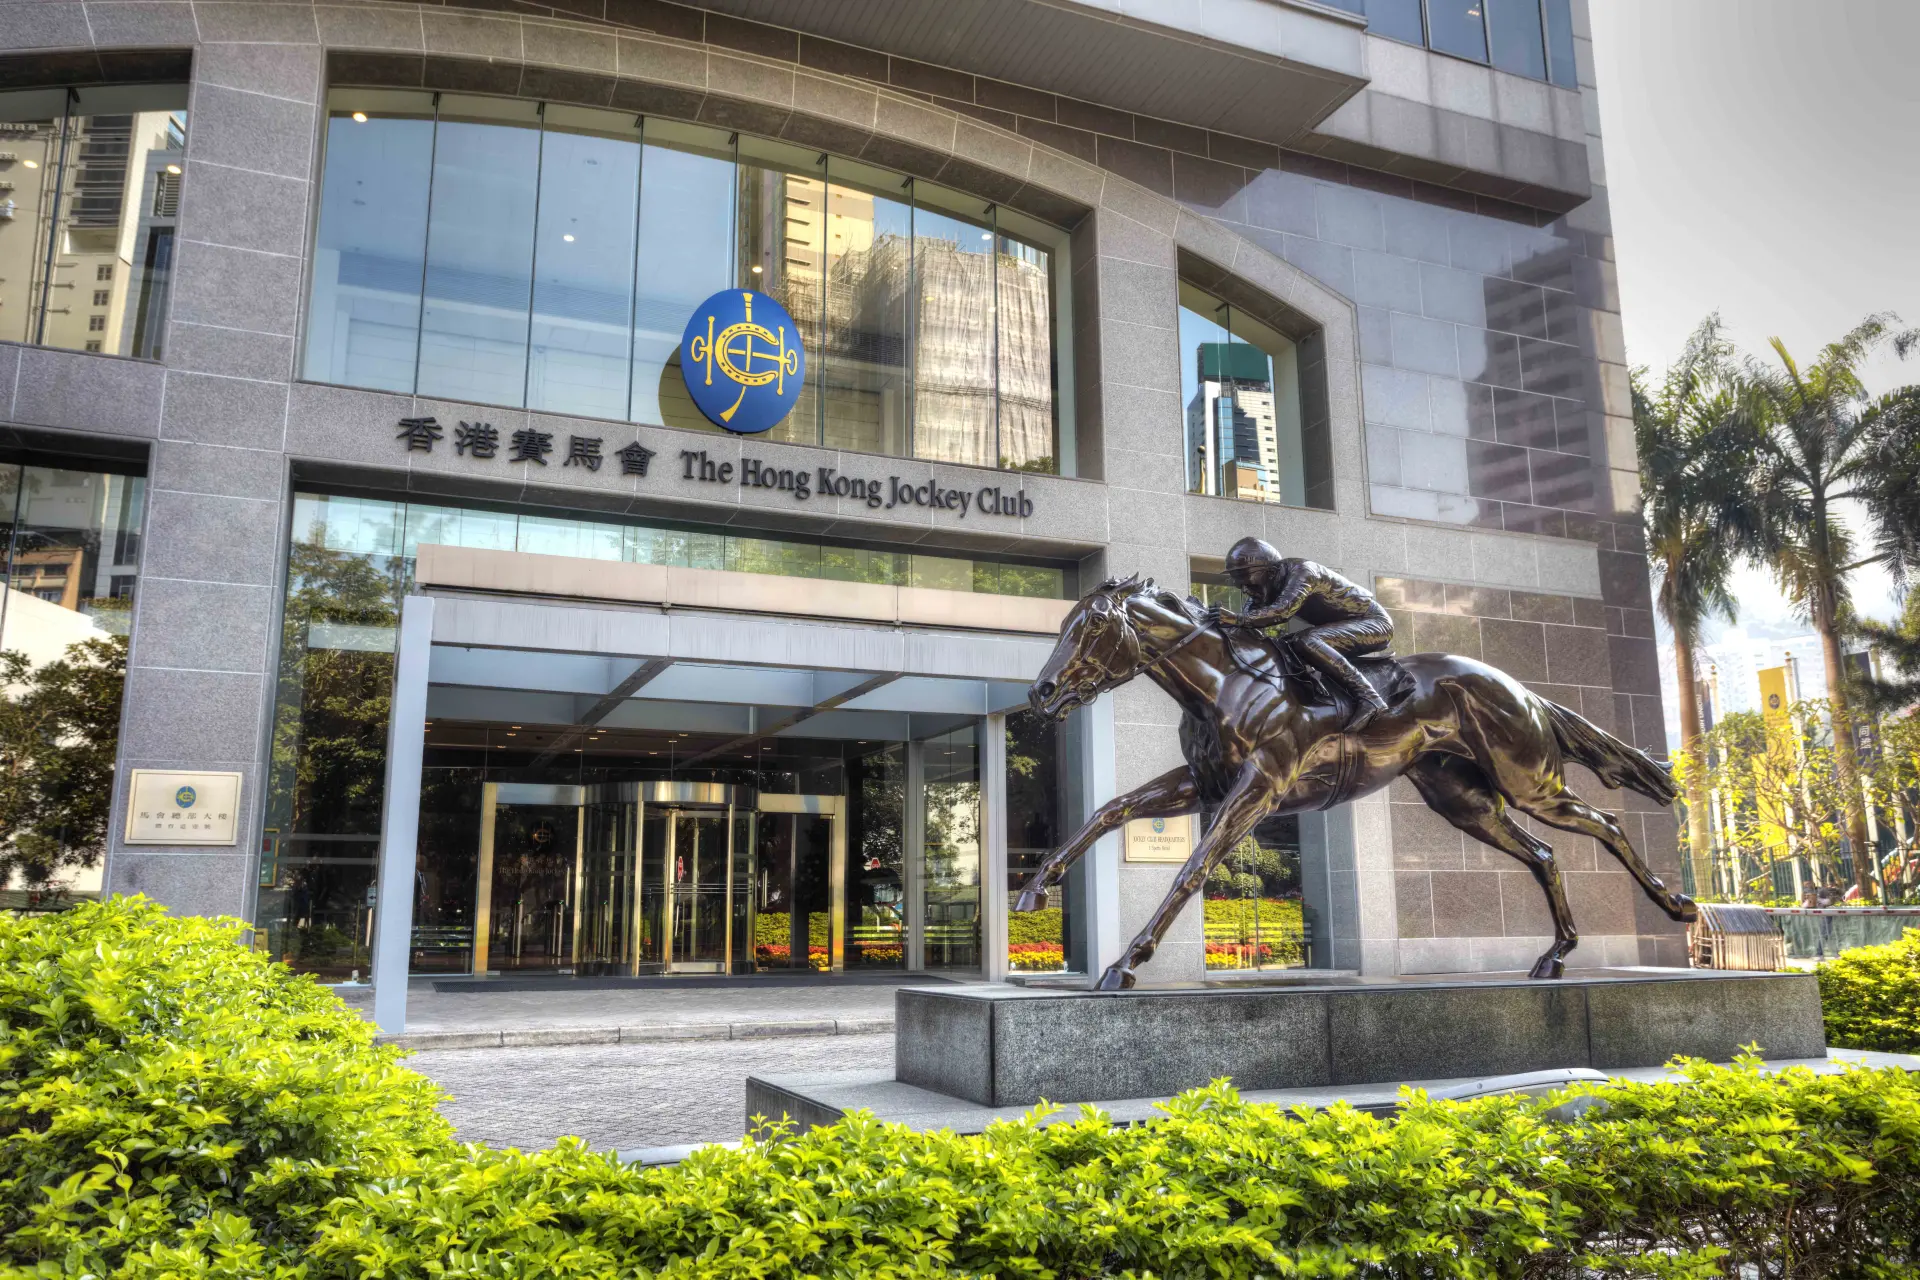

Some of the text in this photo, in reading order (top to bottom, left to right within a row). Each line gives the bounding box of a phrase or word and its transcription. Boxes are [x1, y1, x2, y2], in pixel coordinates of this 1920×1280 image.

[397, 416, 656, 477] 香港賽馬會
[680, 450, 1034, 518] The Hong Kong Jockey Club
